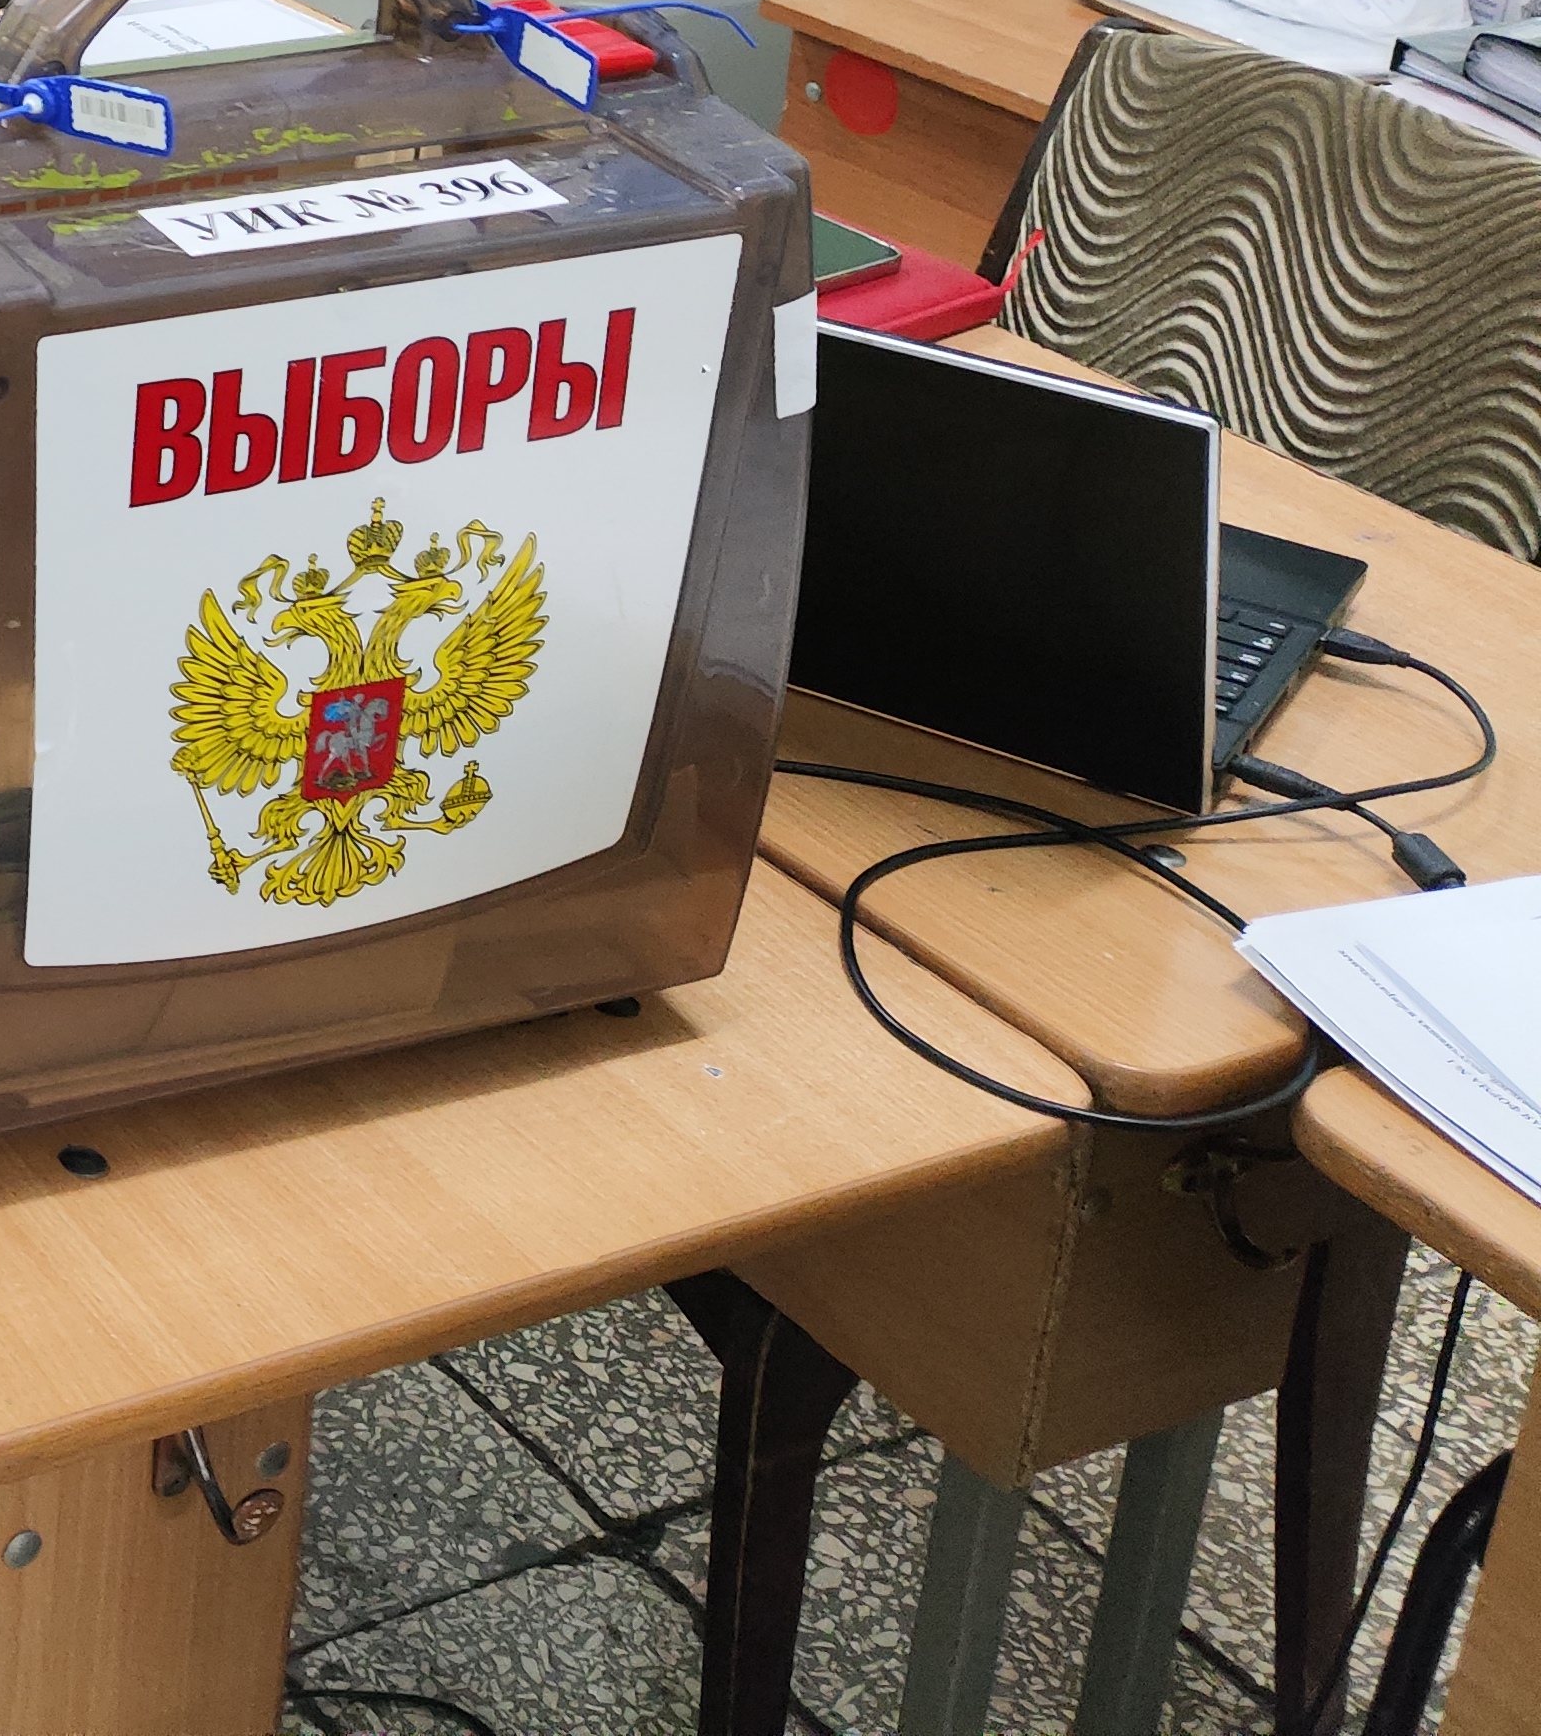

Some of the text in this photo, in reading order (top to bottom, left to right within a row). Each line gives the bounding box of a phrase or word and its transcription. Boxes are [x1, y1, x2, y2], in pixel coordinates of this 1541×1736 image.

[168, 170, 534, 241] УИК № 396
[128, 306, 636, 509] ВЫБОРЫ
